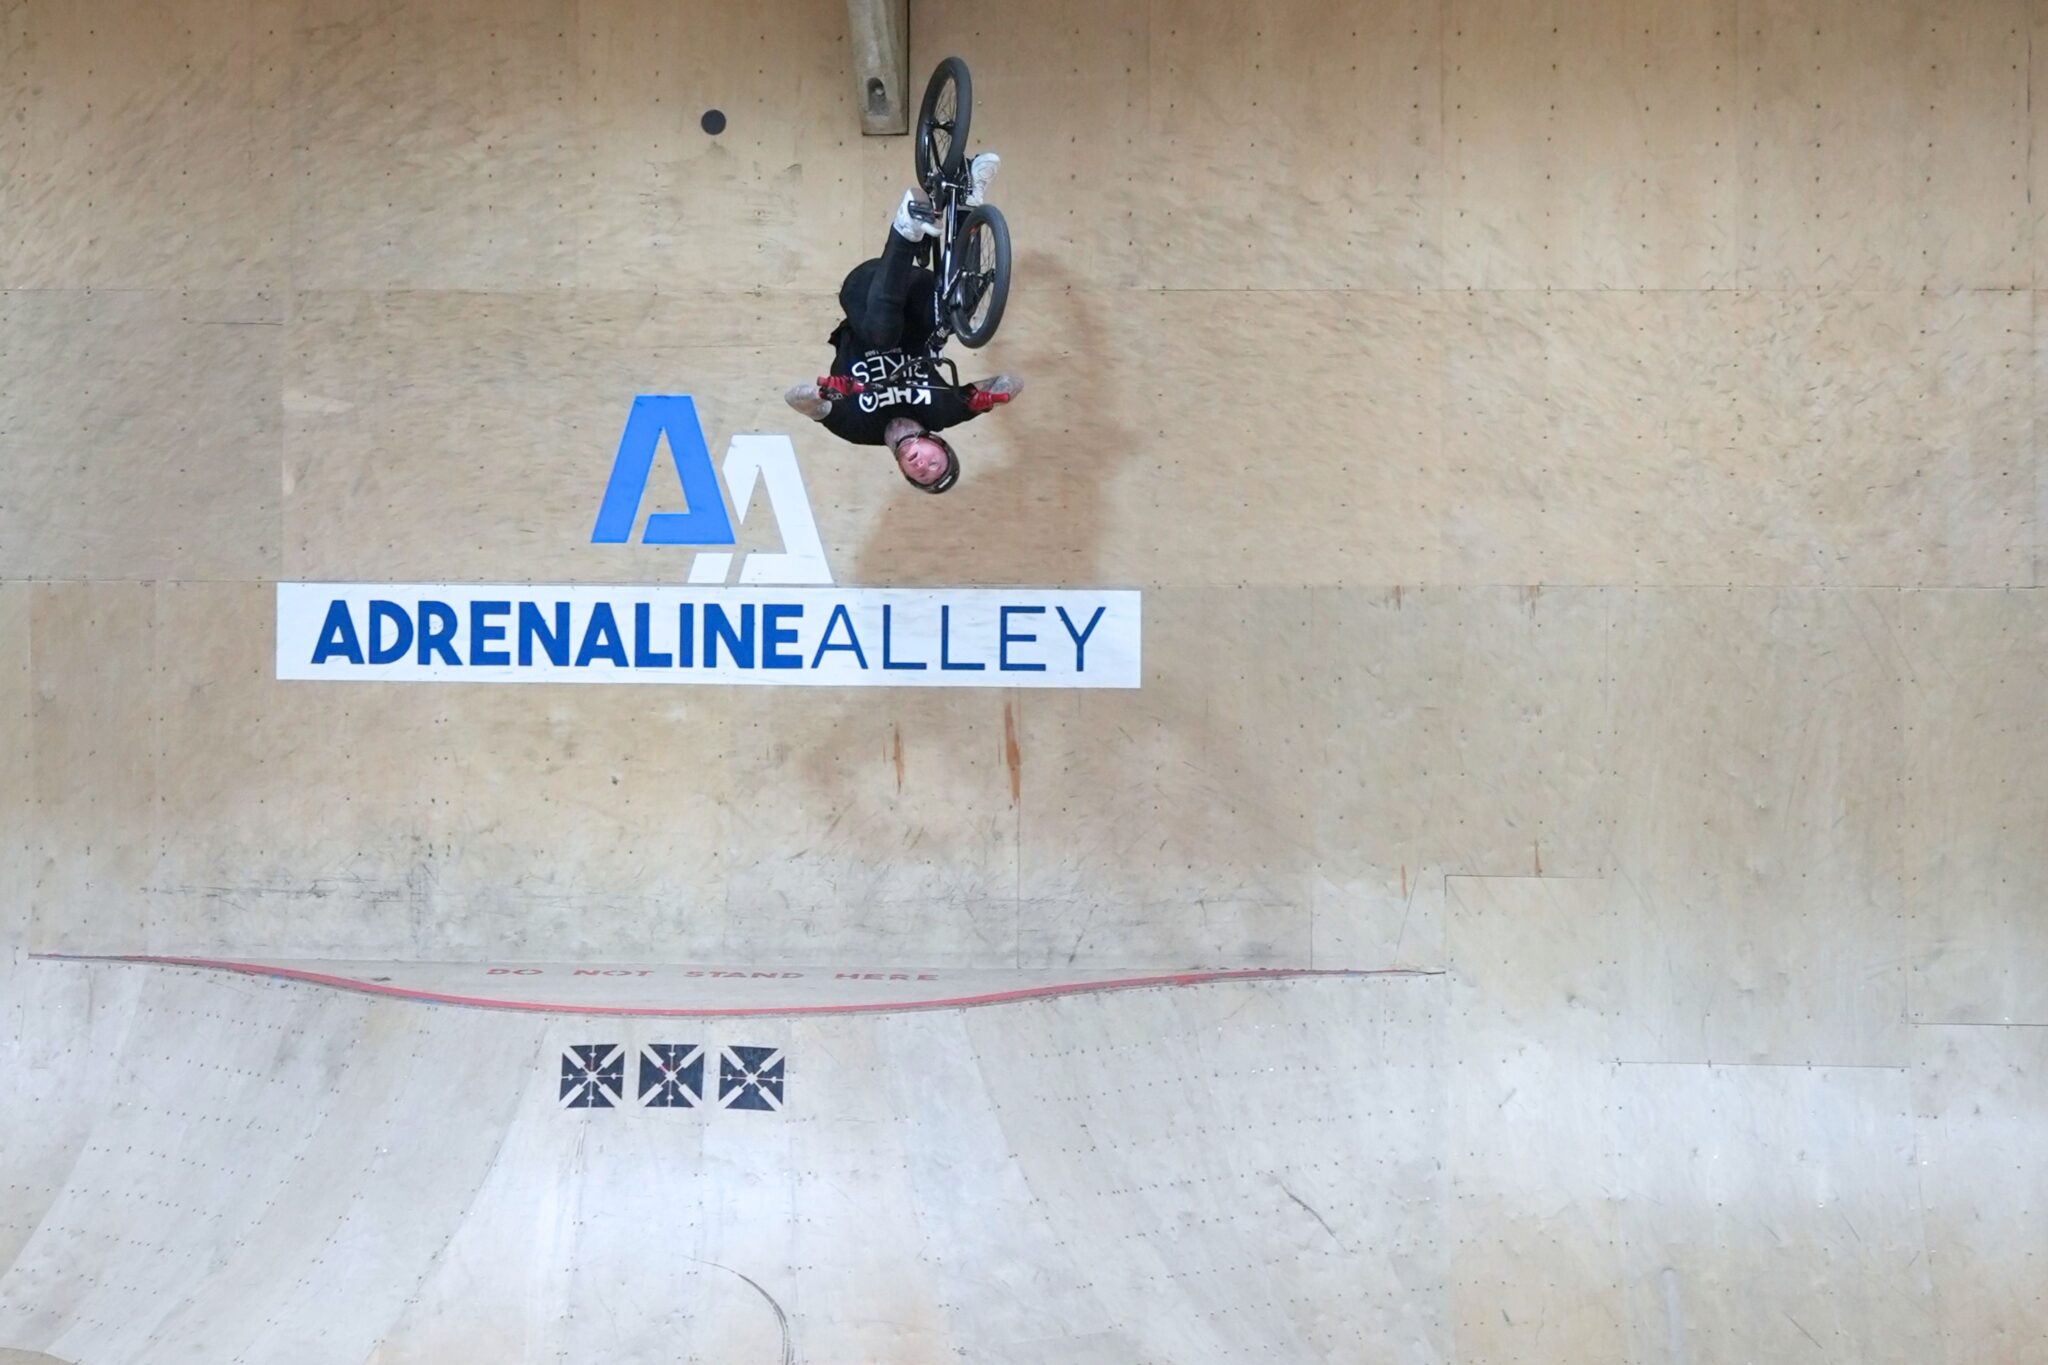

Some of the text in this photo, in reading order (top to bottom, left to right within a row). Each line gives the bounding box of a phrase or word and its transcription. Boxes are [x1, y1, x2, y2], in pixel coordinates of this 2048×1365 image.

[486, 968, 544, 976] DO
[572, 969, 655, 977] NOT
[834, 973, 939, 981] HERE
